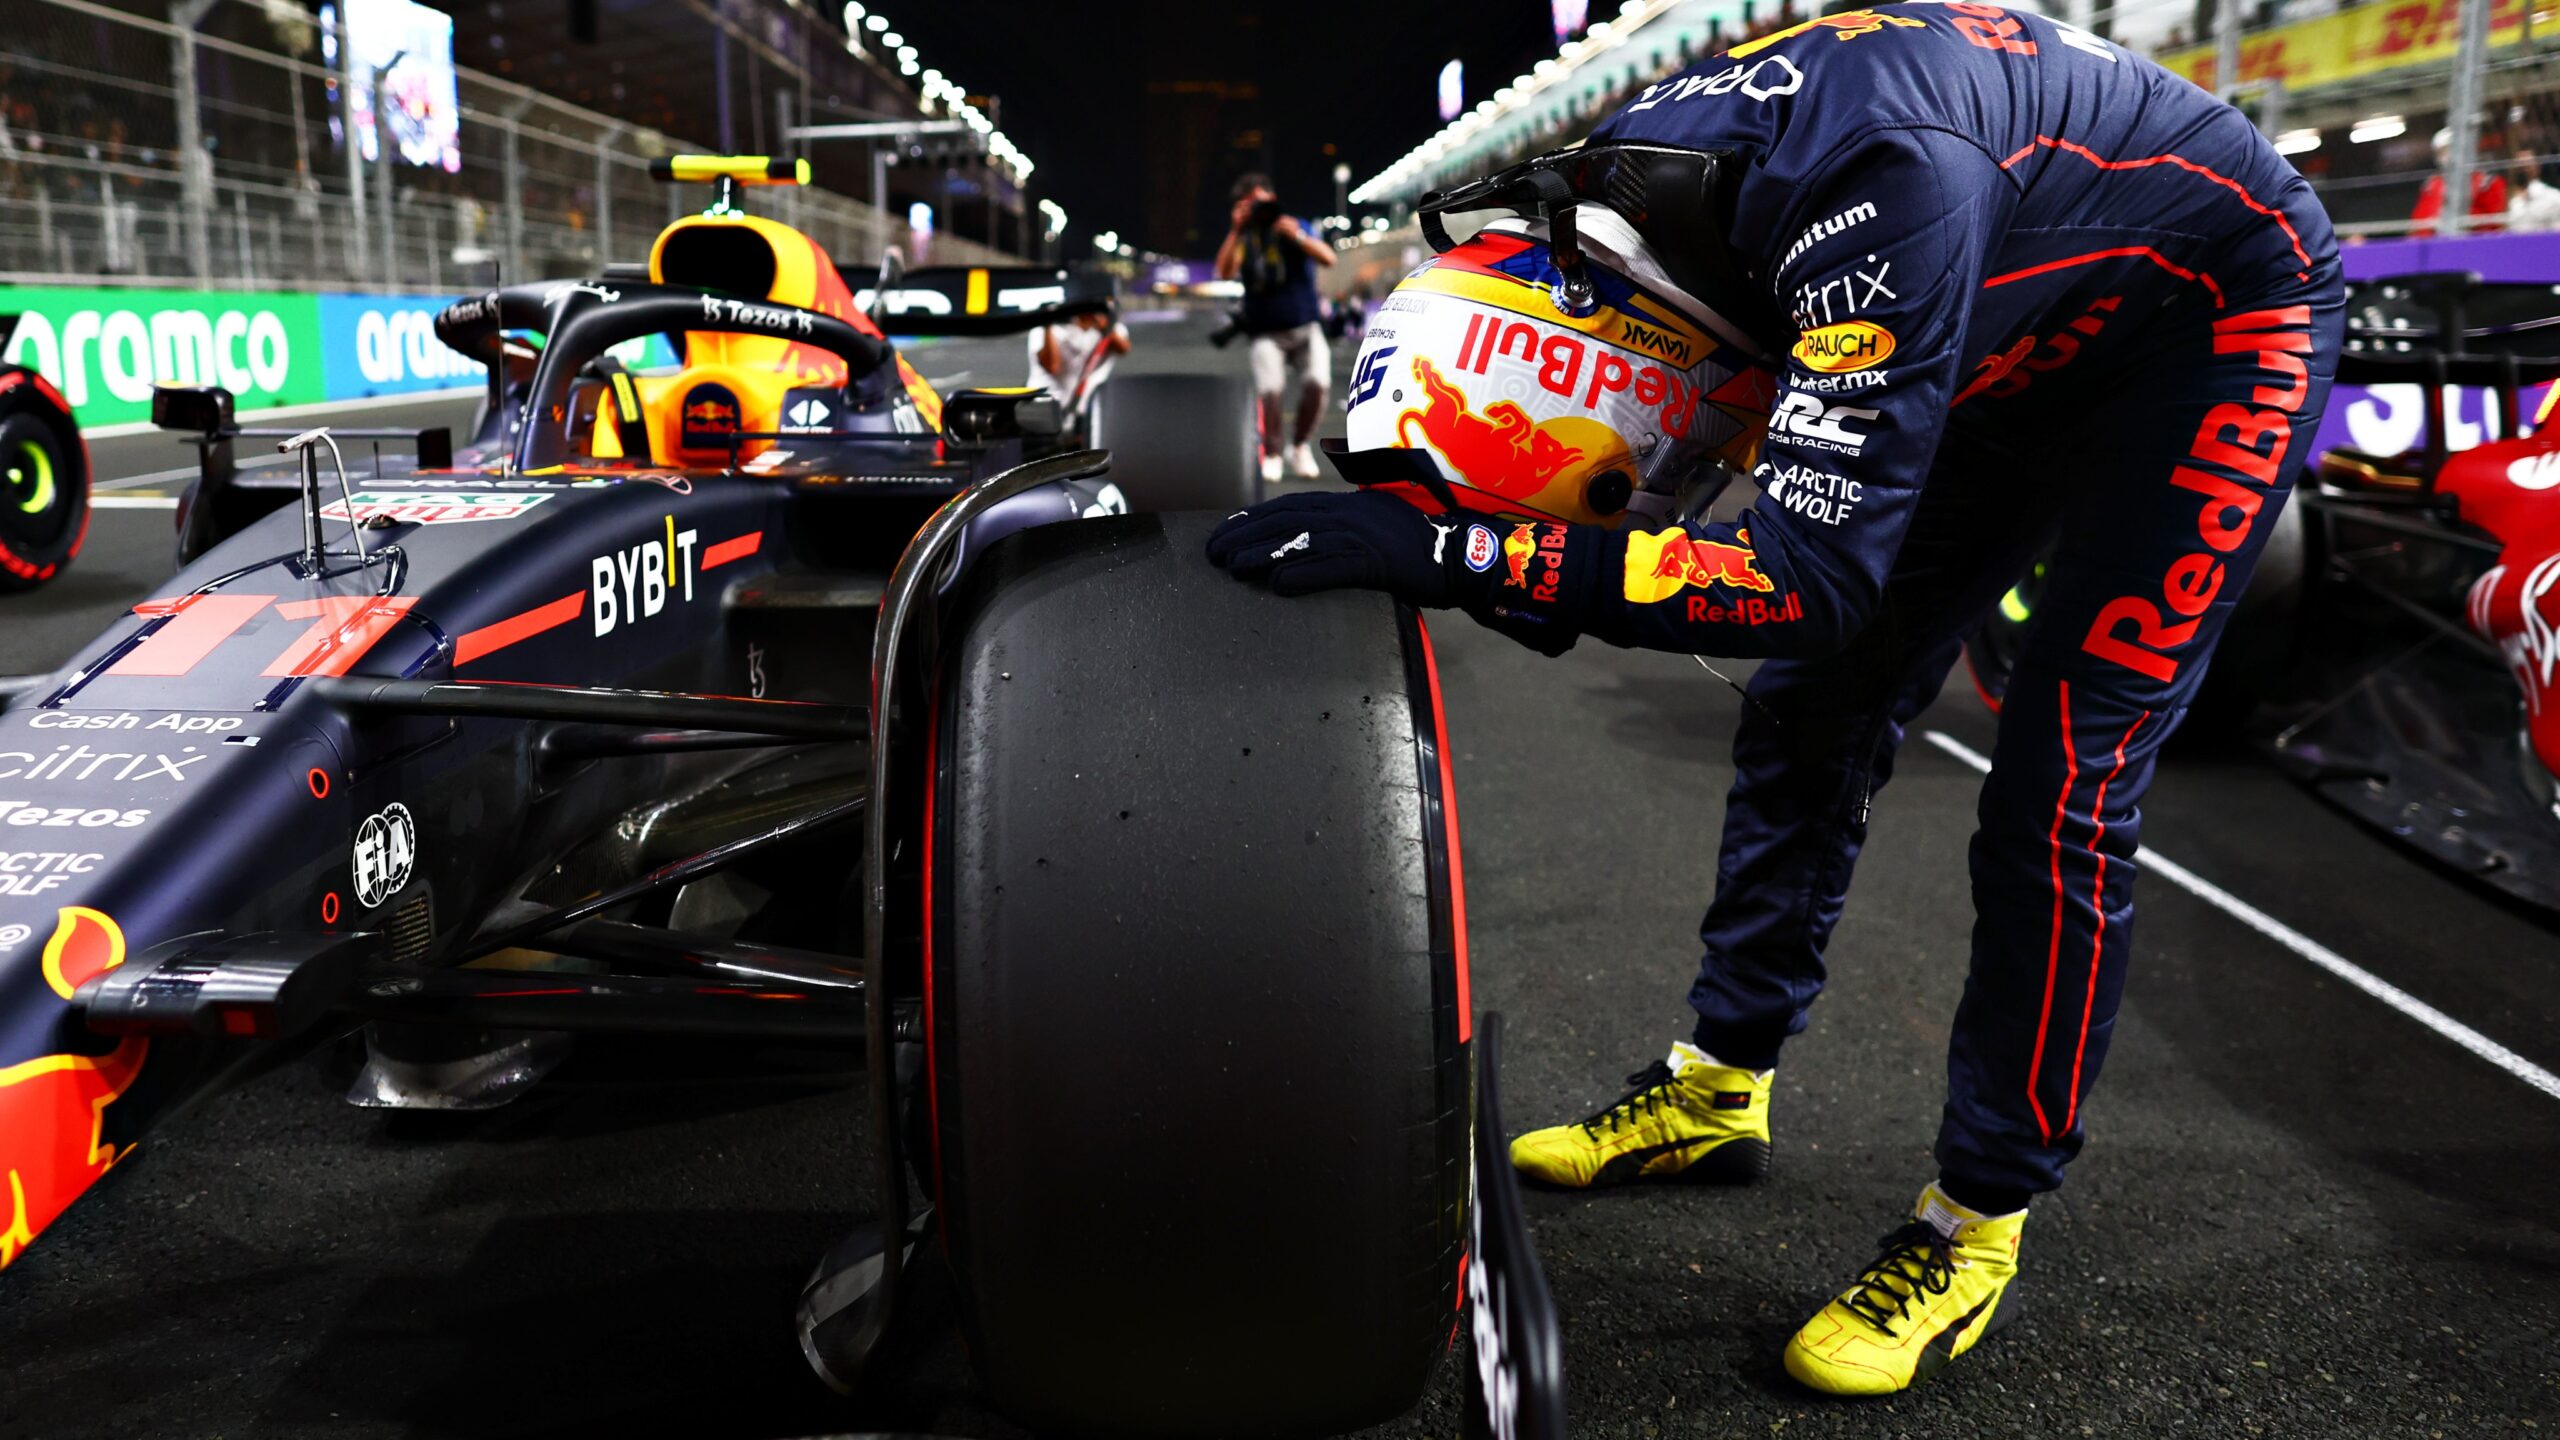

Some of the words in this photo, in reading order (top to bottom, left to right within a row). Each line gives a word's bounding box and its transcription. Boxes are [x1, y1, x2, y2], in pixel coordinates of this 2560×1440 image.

[727, 300, 790, 330] Tezos
[1621, 320, 1691, 365] KAVAK
[1808, 333, 1878, 357] RAUCH
[1791, 437, 1861, 457] RACING
[1784, 464, 1863, 503] ARCTIC
[1785, 487, 1853, 526] WOLF
[592, 514, 698, 638] BYBIT
[28, 711, 142, 730] Cash
[144, 712, 244, 734] App
[0, 852, 105, 873] CTIC
